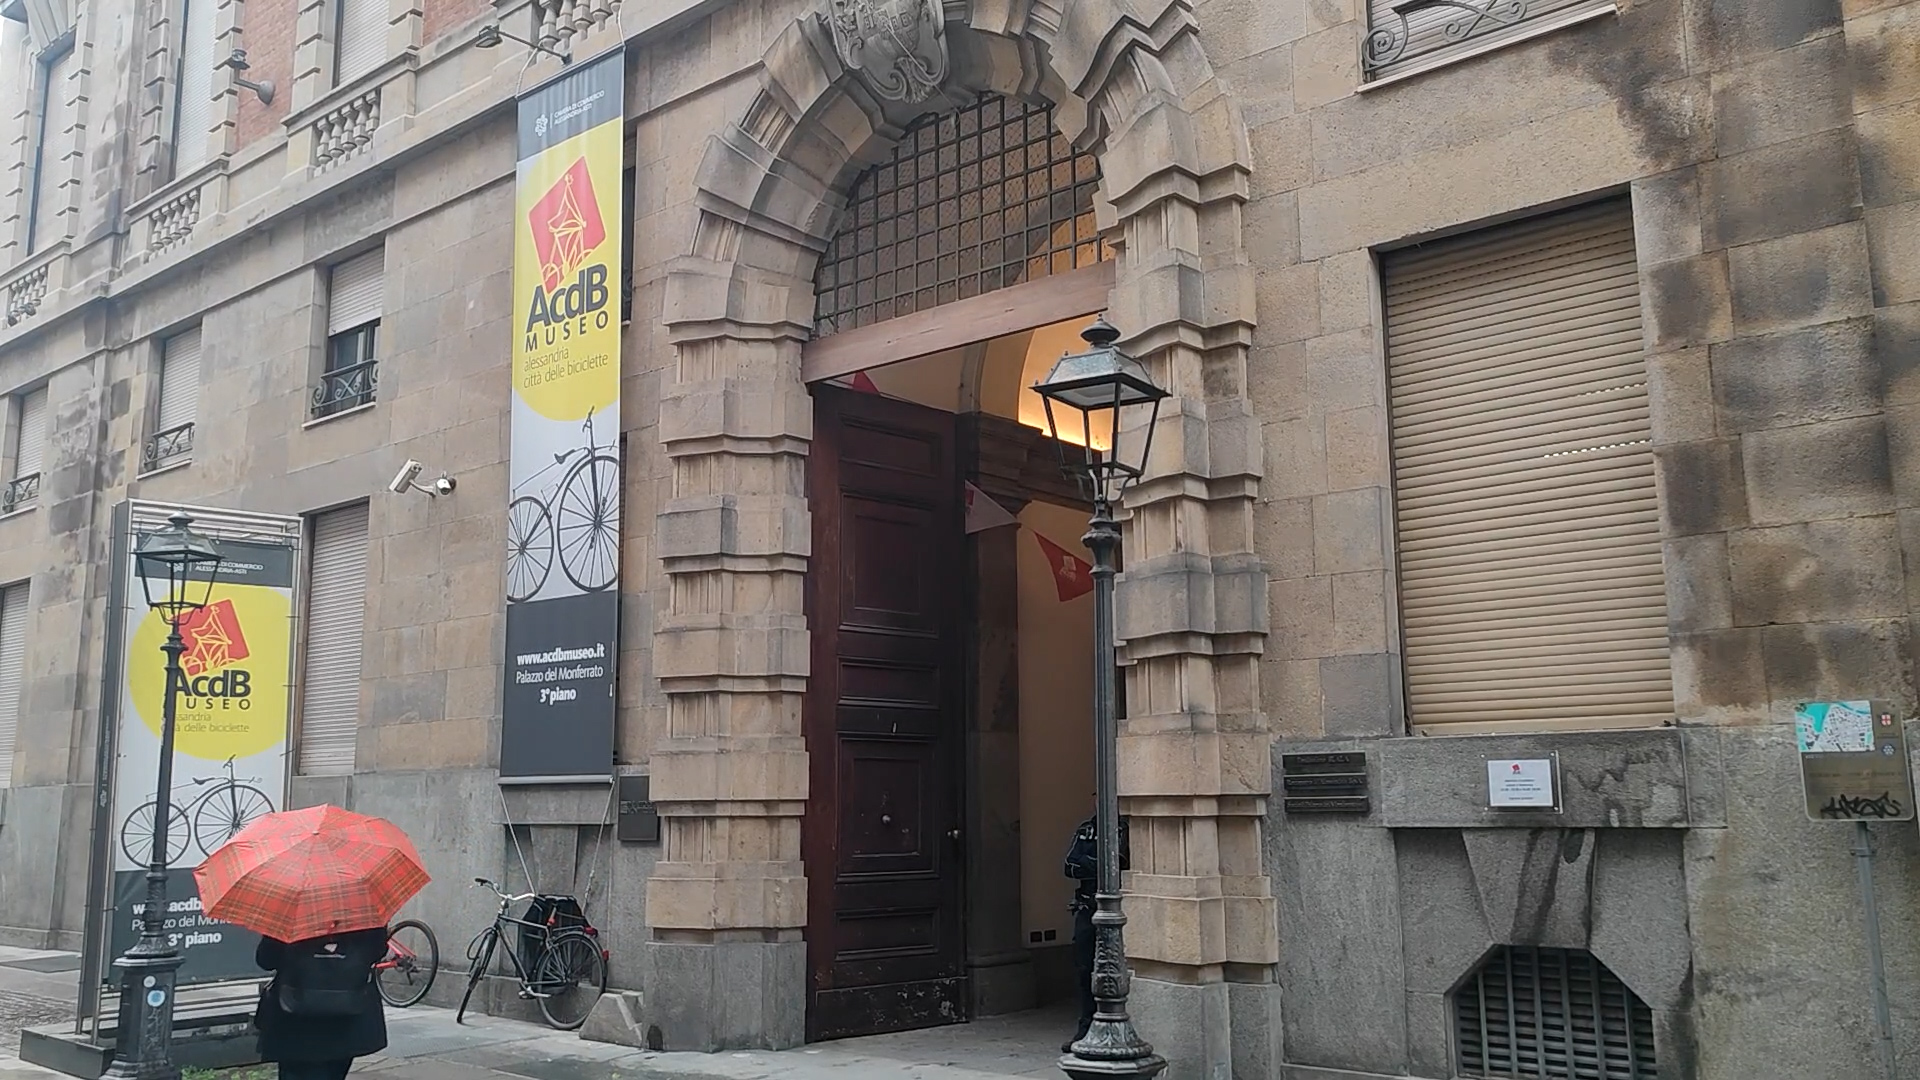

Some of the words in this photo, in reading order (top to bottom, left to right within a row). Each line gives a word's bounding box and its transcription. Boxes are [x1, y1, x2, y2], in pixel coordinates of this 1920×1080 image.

[525, 263, 609, 334] AcdB
[524, 310, 609, 354] MUSEO
[523, 346, 570, 373] alessandria
[523, 371, 542, 389] città
[544, 364, 565, 383] delle
[567, 353, 609, 376] biciclette
[516, 642, 606, 666] www.acdbmuseo.it
[174, 667, 252, 698] AcdB
[515, 670, 543, 684] Palazzo
[545, 667, 557, 681] del
[558, 664, 604, 681] Monferrato
[186, 697, 251, 711] USEO
[131, 918, 176, 931] Pazo
[178, 914, 196, 928] del
[167, 932, 184, 947] 3°
[184, 931, 223, 949] piano
